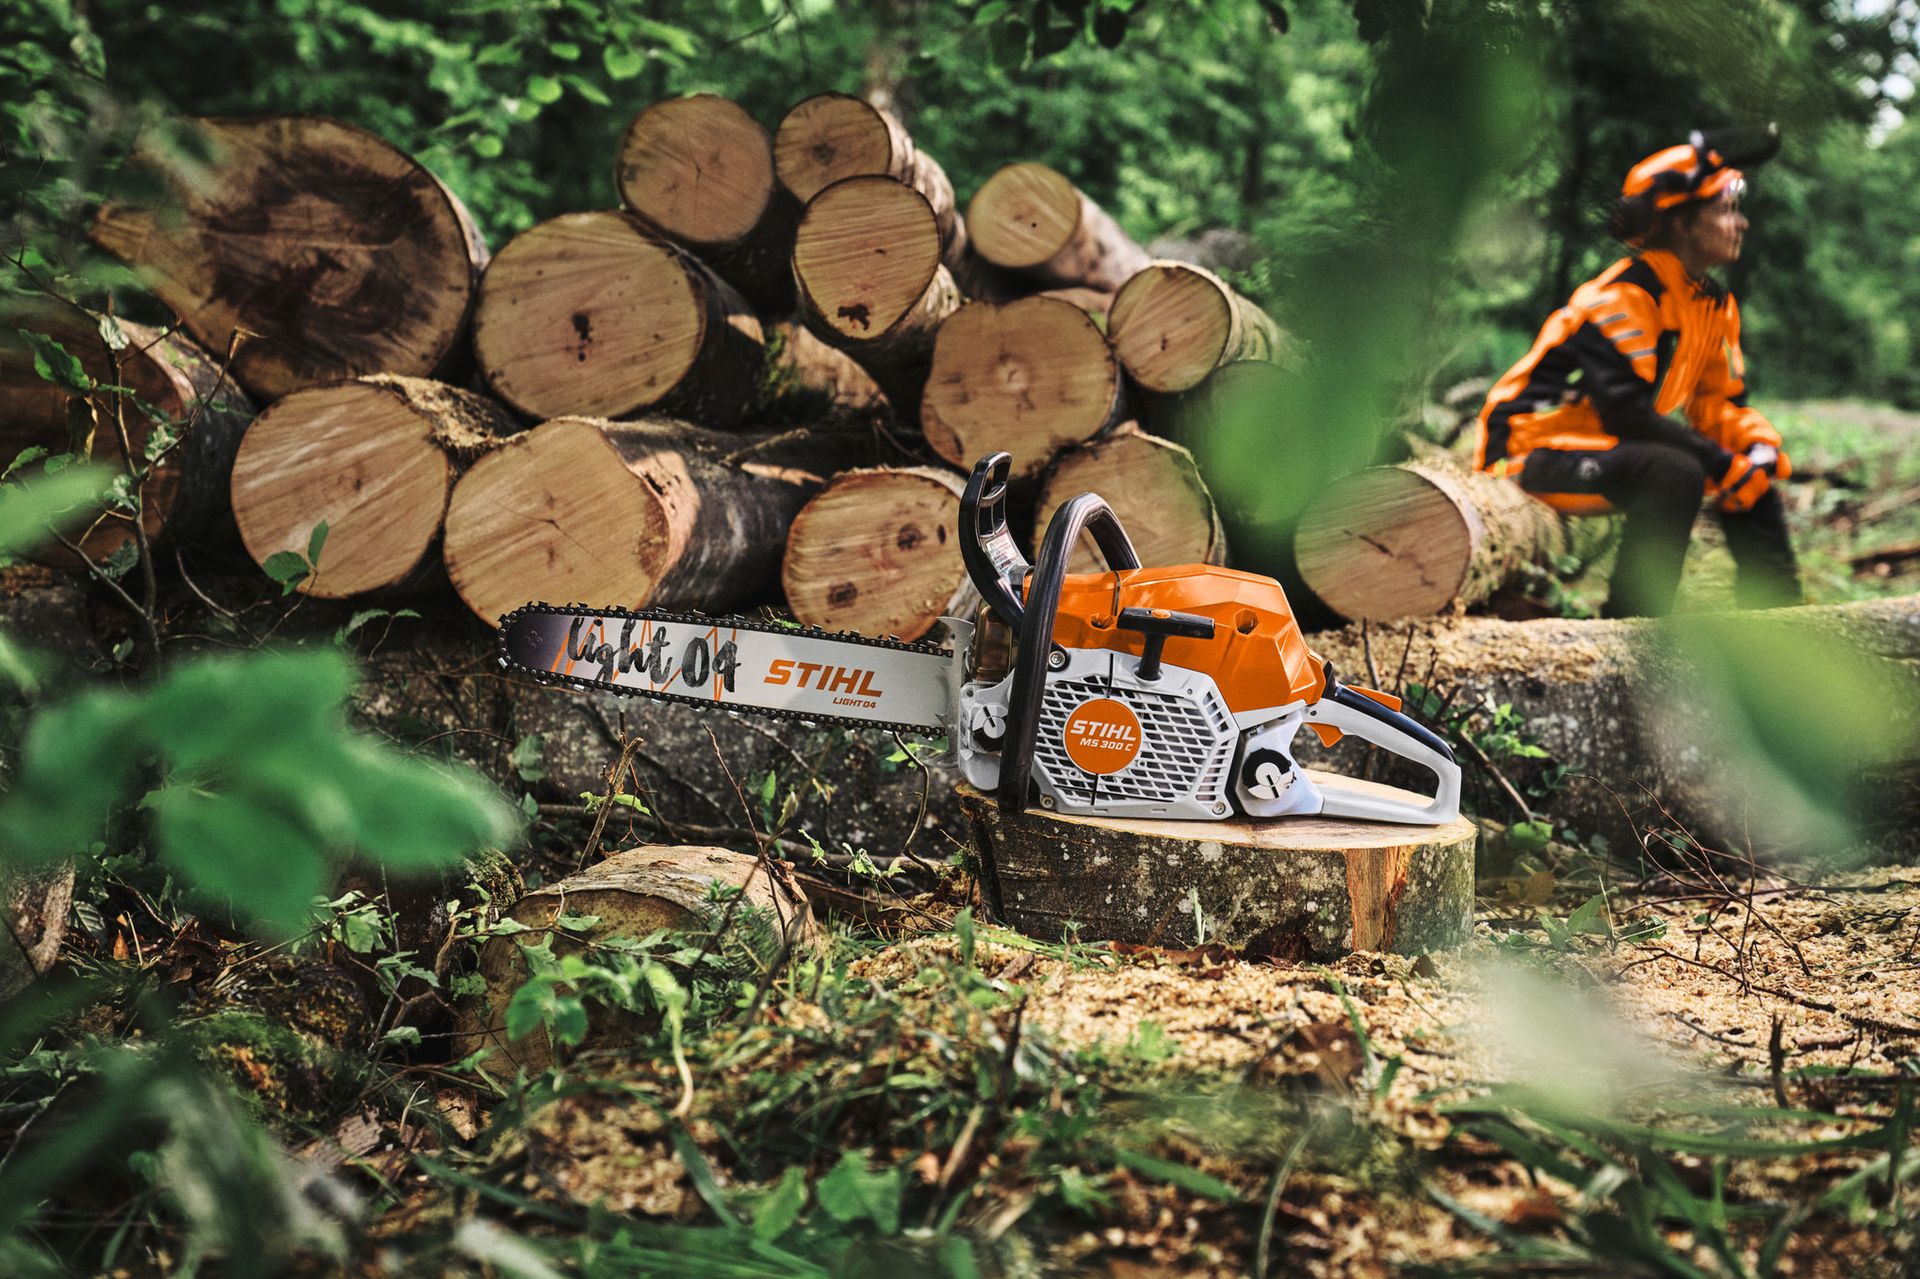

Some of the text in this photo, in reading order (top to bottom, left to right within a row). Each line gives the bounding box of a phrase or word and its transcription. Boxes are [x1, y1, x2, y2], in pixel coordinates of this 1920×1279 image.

[567, 617, 742, 692] light 04
[764, 659, 883, 697] STIHL
[833, 697, 863, 707] LIGHT
[1070, 720, 1137, 741] STIHL
[1080, 738, 1134, 752] MS 300 C
